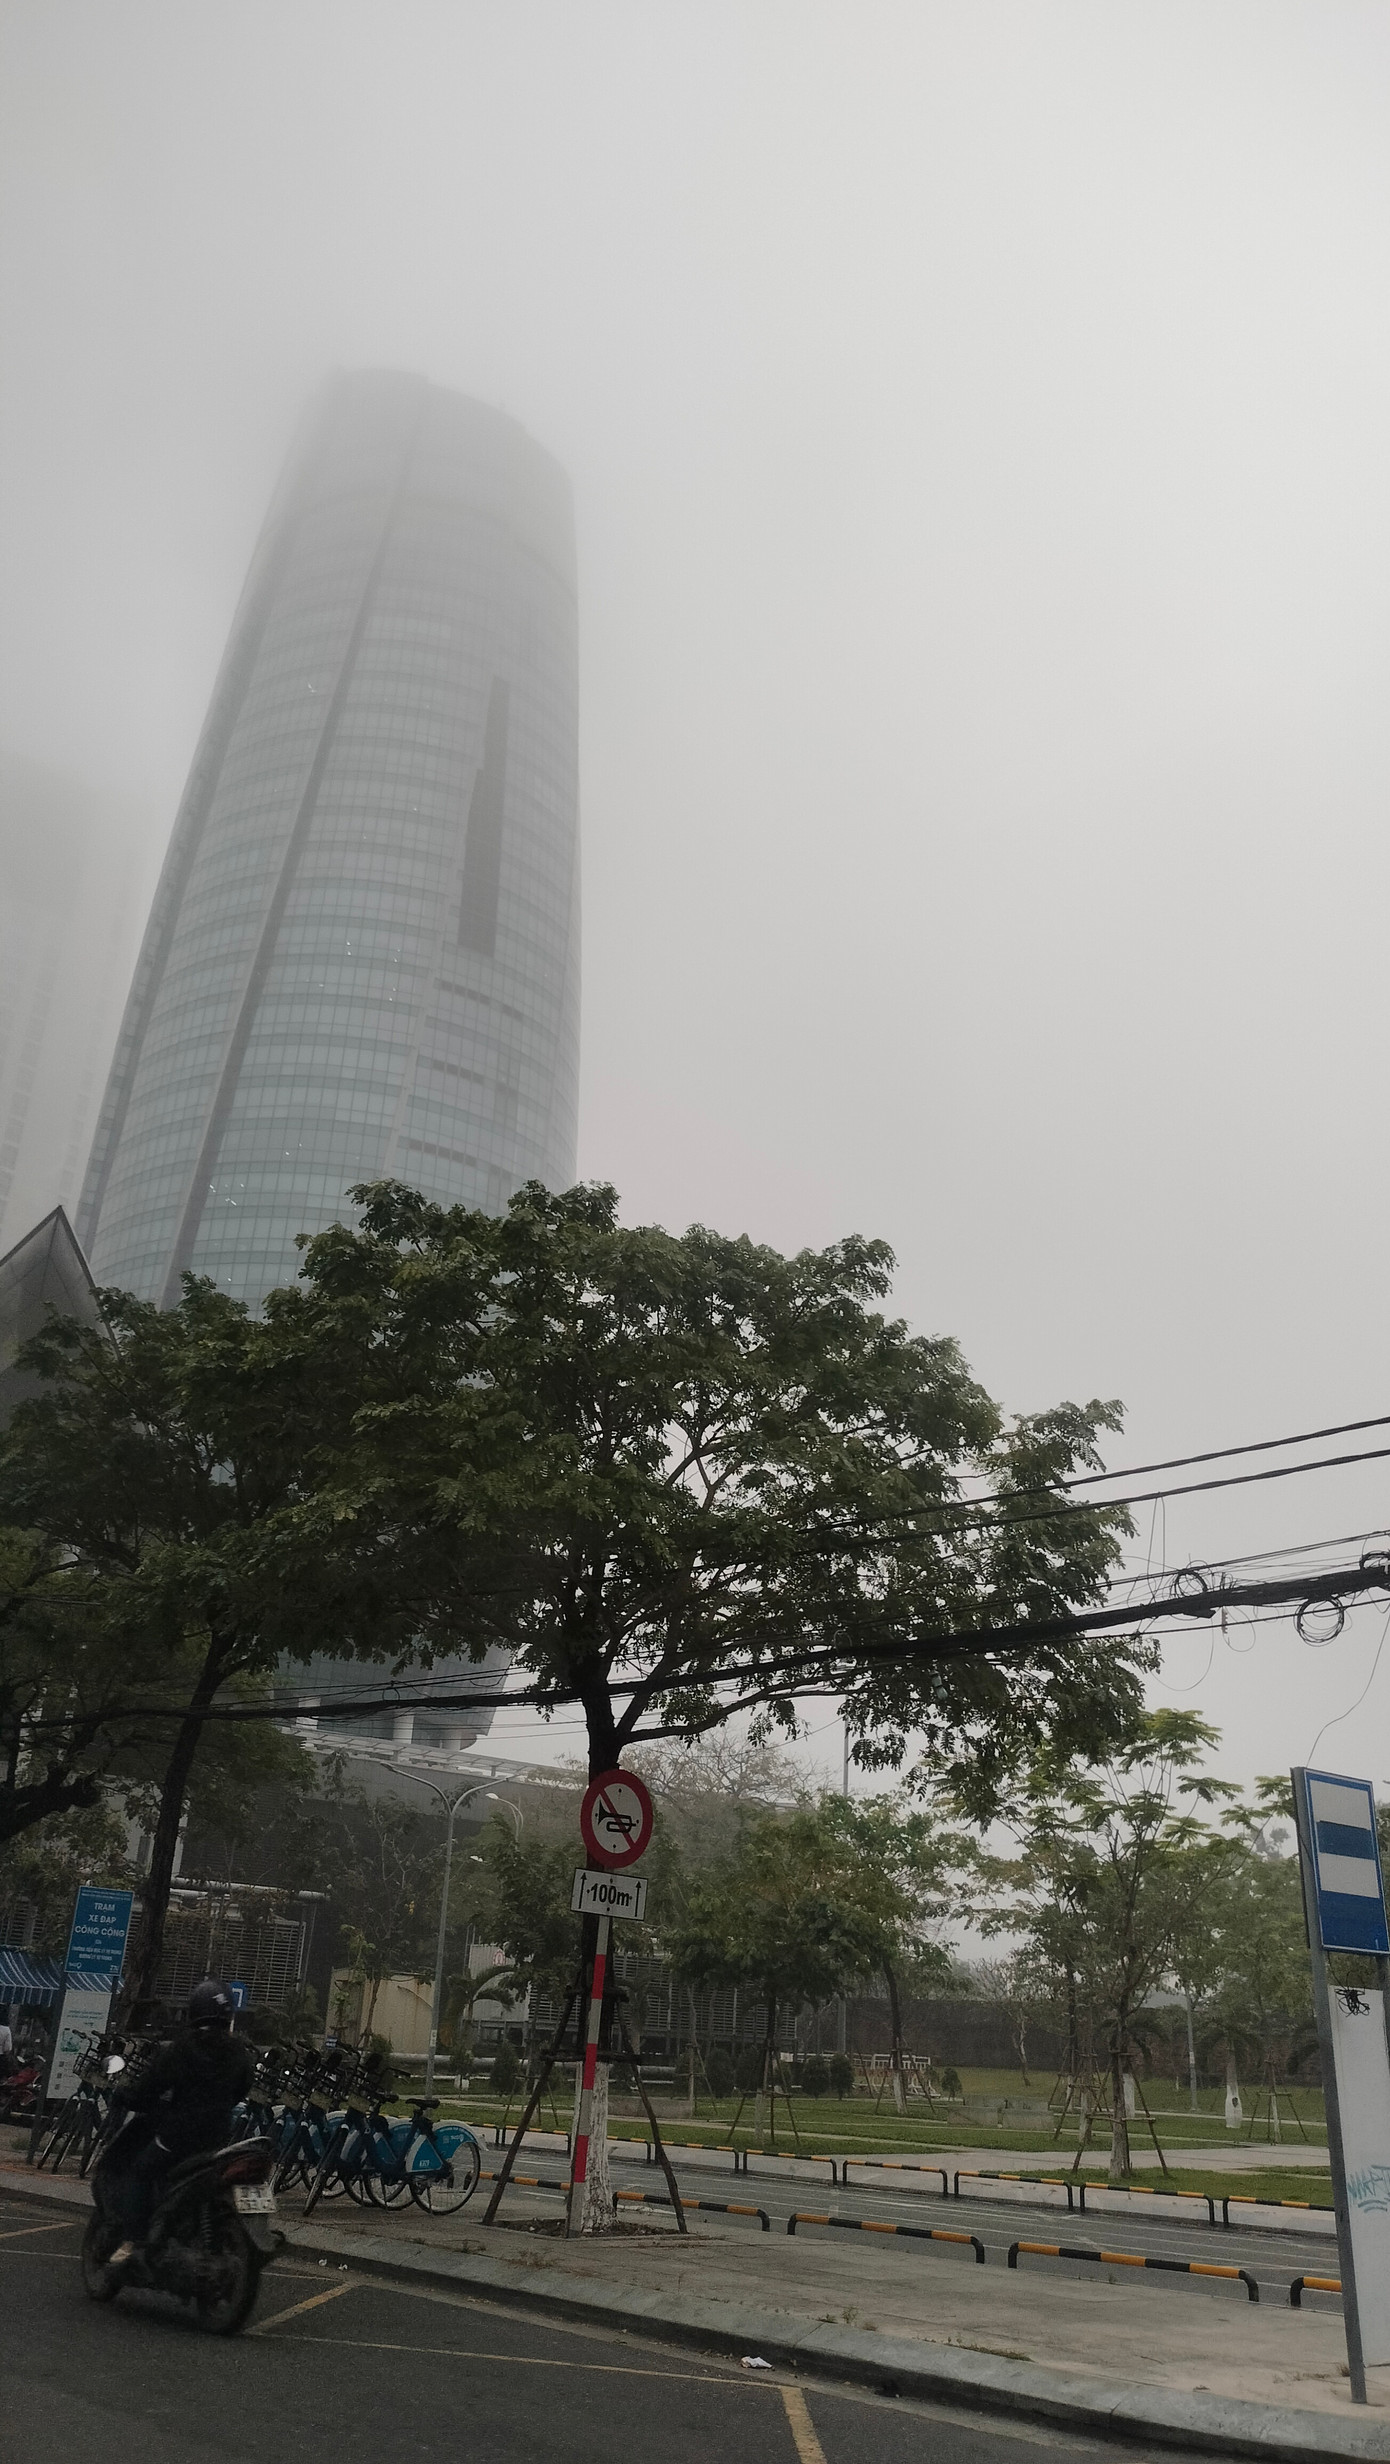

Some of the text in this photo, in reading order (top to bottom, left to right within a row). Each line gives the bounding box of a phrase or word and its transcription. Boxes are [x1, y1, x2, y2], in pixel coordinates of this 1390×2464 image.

[591, 1883, 630, 1907] 100m
[94, 1902, 116, 1912] TRẠM
[88, 1914, 117, 1926] XE ĐẠP
[74, 1924, 125, 1938] CÔNG CỘNG
